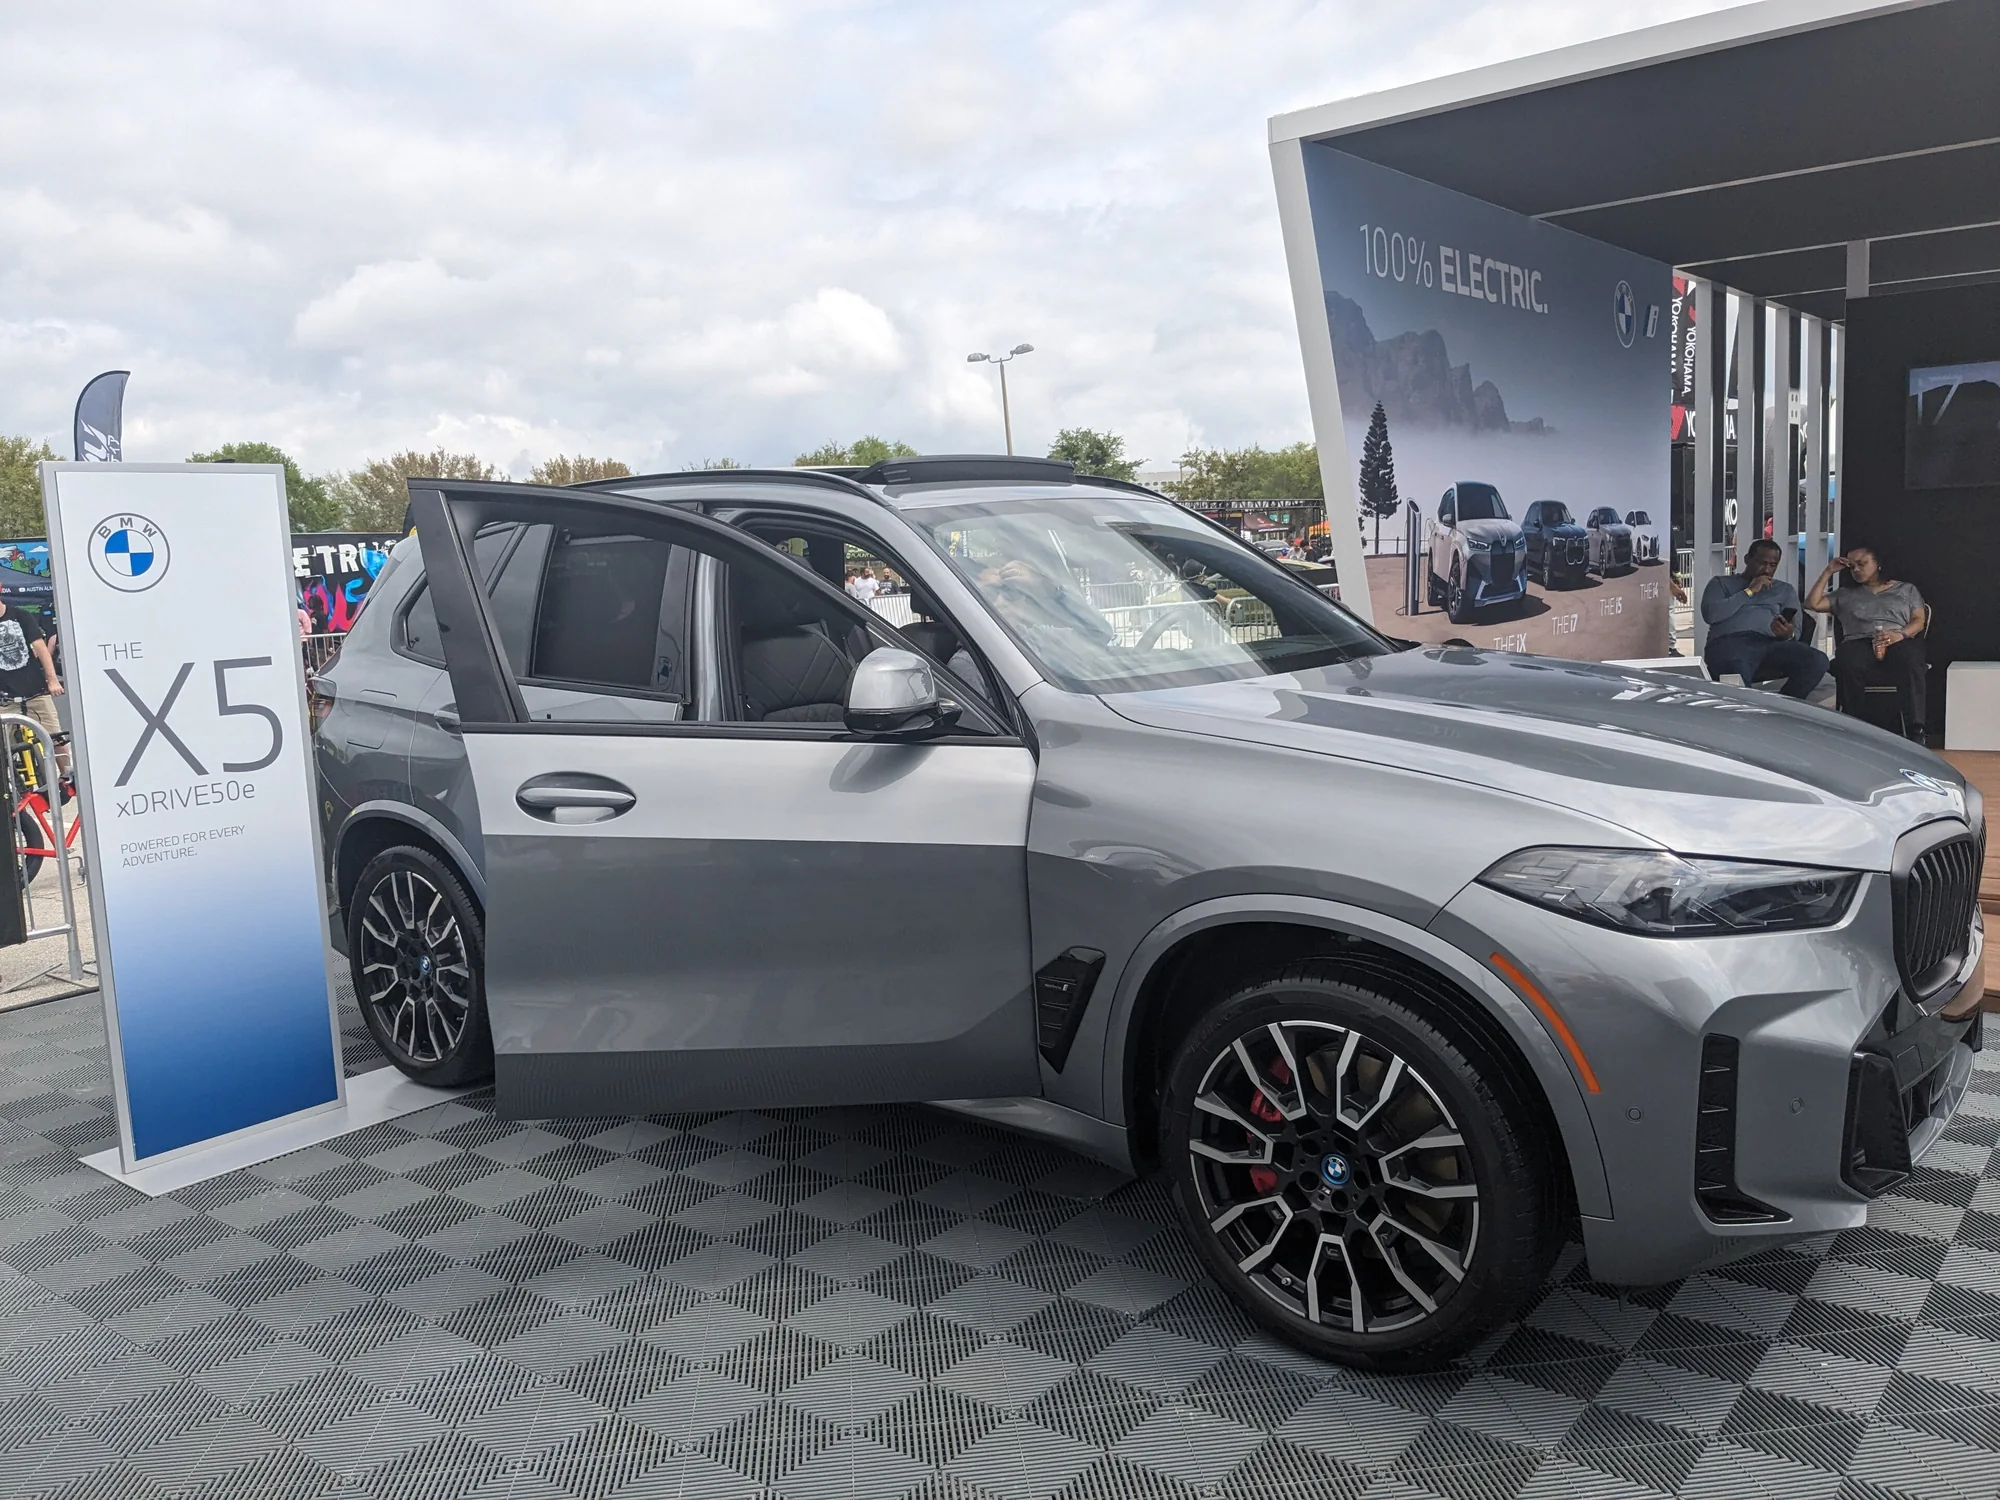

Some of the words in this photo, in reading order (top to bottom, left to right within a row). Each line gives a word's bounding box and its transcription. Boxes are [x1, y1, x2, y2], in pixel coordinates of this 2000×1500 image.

[1359, 223, 1433, 288] 100%
[1439, 245, 1549, 314] ELECTRIC.
[1684, 326, 1697, 394] YOKOHAMA
[1640, 583, 1652, 600] THE
[1600, 599, 1615, 617] THE
[1552, 615, 1569, 636] THE
[1570, 613, 1578, 632] i7
[97, 641, 144, 662] THE
[1516, 633, 1527, 652] iX
[103, 656, 283, 788] X5
[116, 780, 256, 818] xDRIVE50e
[120, 835, 180, 854] POWERED
[182, 830, 207, 845] FOR
[209, 825, 246, 840] EVERY
[122, 846, 198, 868] ADVENTURE.
